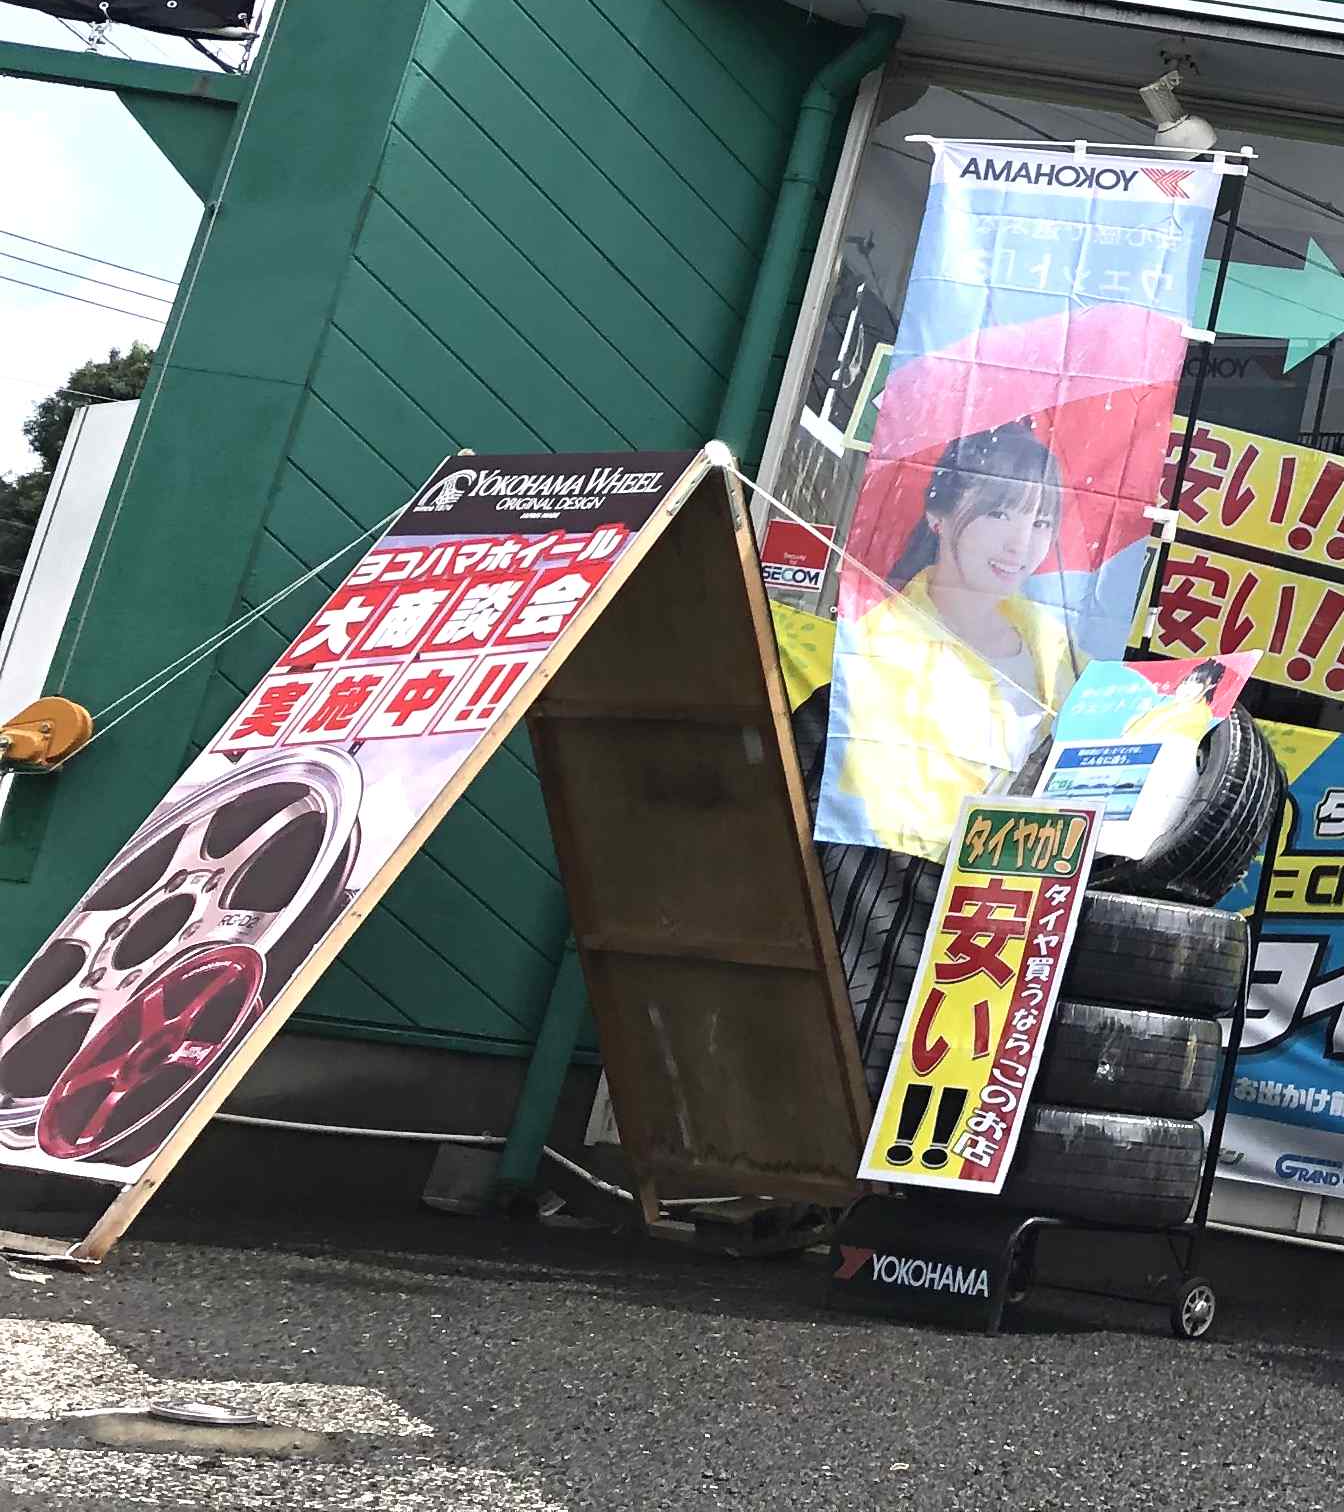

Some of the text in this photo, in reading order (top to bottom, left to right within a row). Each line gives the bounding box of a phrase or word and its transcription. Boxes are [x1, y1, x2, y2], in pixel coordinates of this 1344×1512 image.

[467, 467, 664, 498] YOKOHAMA WHEEL
[348, 529, 625, 586] ヨコハマホイール
[763, 566, 820, 586] SECOM
[290, 571, 593, 663] 大商談会
[228, 662, 528, 740] 実施中!!
[963, 812, 1090, 875] タイヤが!
[952, 883, 1072, 1167] タイヤ買うならこのお店
[1275, 1153, 1341, 1186] GRAND
[870, 1253, 990, 1298] YOKOHAMA
